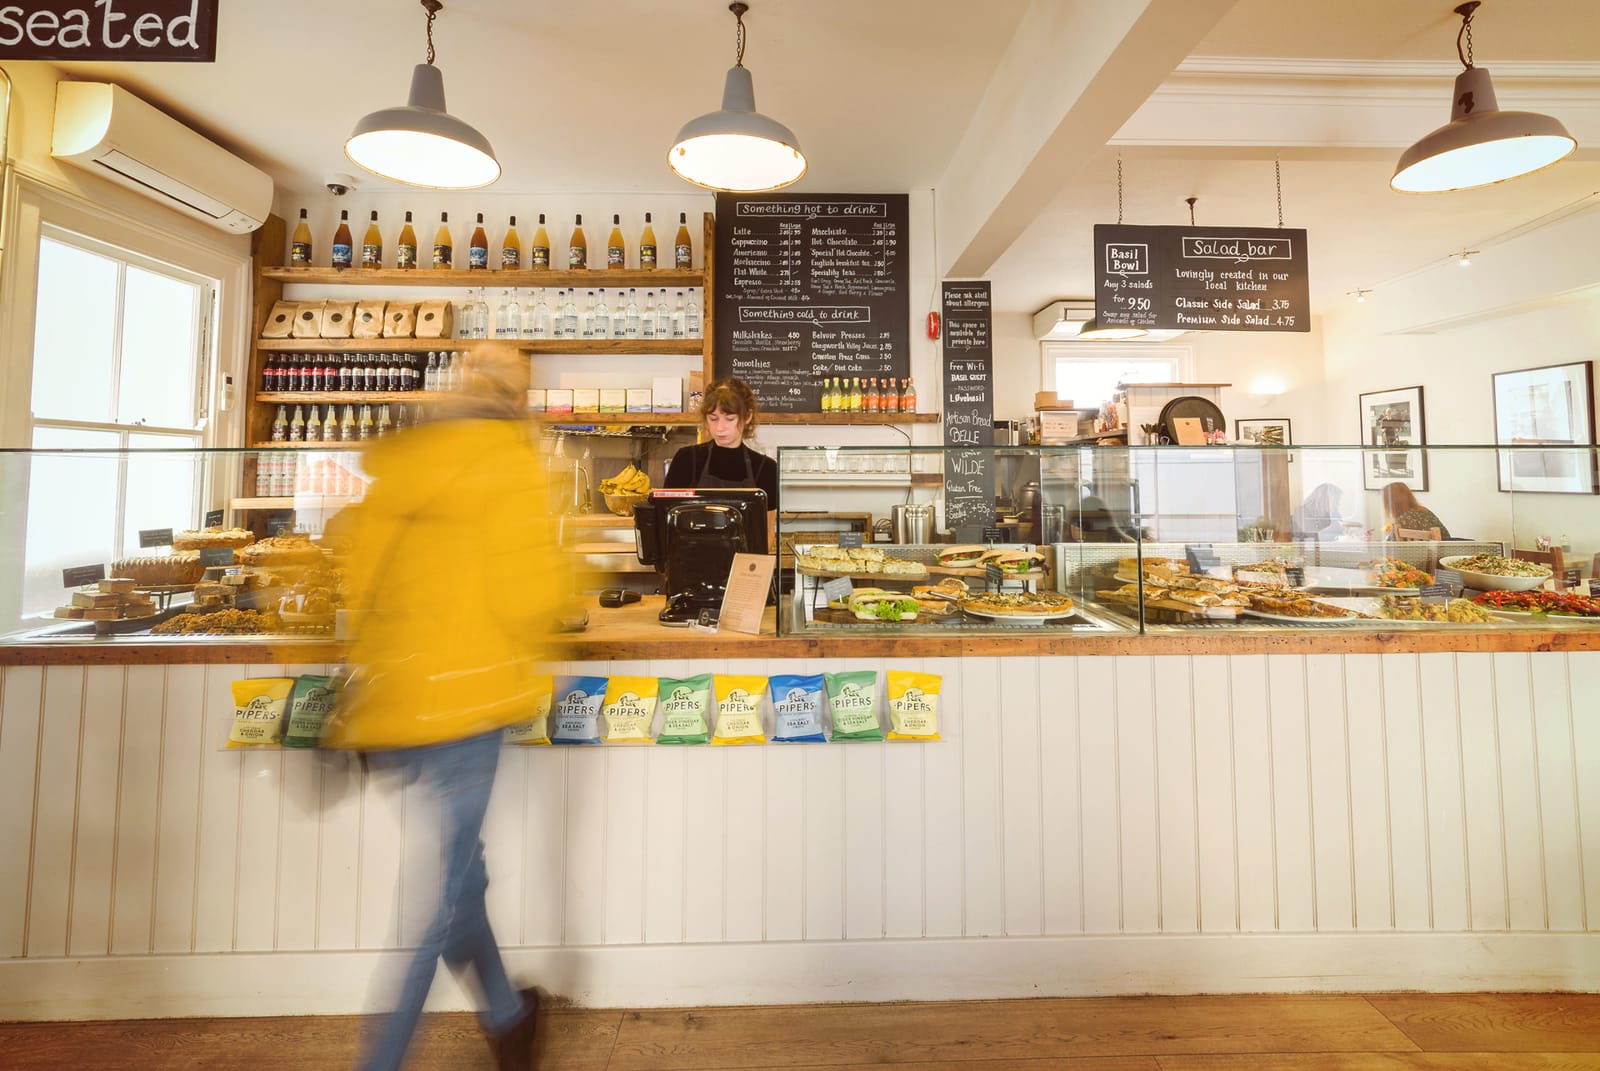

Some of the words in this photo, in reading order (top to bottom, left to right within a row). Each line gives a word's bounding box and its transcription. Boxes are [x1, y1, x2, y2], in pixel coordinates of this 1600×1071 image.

[0, 0, 199, 49] seated
[742, 204, 800, 214] Something
[804, 204, 821, 214] hot
[828, 205, 838, 214] to
[844, 204, 877, 214] drink
[734, 226, 752, 235] Latte
[732, 238, 768, 247] Cappuccino
[827, 237, 858, 246] Chocolate
[1193, 240, 1240, 256] Salad
[1247, 241, 1278, 256] bar
[1111, 248, 1138, 260] Basil
[811, 259, 834, 268] English
[1114, 260, 1139, 271] Bowl
[1176, 268, 1214, 281] Lovingly
[1220, 269, 1253, 280] created
[1259, 271, 1268, 280] in
[1273, 272, 1289, 280] our
[734, 278, 762, 287] Espresso
[1104, 280, 1119, 291] Any
[1121, 280, 1127, 288] 3
[1128, 281, 1153, 290] salads
[1205, 281, 1227, 290] local
[1236, 282, 1267, 291] kitchen
[964, 300, 989, 308] allergens
[1113, 294, 1125, 303] for
[1128, 297, 1150, 311] 9.50
[1176, 297, 1209, 308] Classic
[1213, 298, 1232, 309] Side
[1236, 299, 1260, 310] Salad
[742, 309, 794, 319] Something
[796, 310, 814, 318] cold
[820, 310, 828, 318] to
[832, 310, 859, 319] drink
[1177, 313, 1216, 324] Premium
[1221, 314, 1240, 325] Side
[1244, 314, 1269, 326] Salad
[1276, 316, 1295, 326] 4.75
[962, 322, 977, 333] space
[733, 330, 773, 339] Milkshakes
[841, 331, 865, 339] Presses
[846, 342, 860, 351] Valley
[952, 338, 972, 347] private
[732, 358, 770, 368] Smoothies
[950, 362, 963, 371] Free
[946, 411, 971, 427] Artisan
[972, 409, 991, 427] Bread
[951, 457, 985, 475] WILDE
[946, 480, 966, 492] Gluten
[968, 480, 983, 493] Free
[295, 702, 332, 712] PIPERS
[665, 701, 700, 711] PIPERS
[835, 697, 872, 708] PIPERS
[897, 702, 931, 711] PIPERS
[610, 708, 646, 717] PIPERS
[779, 704, 814, 712] PIPERS
[236, 710, 276, 720] PIPERS
